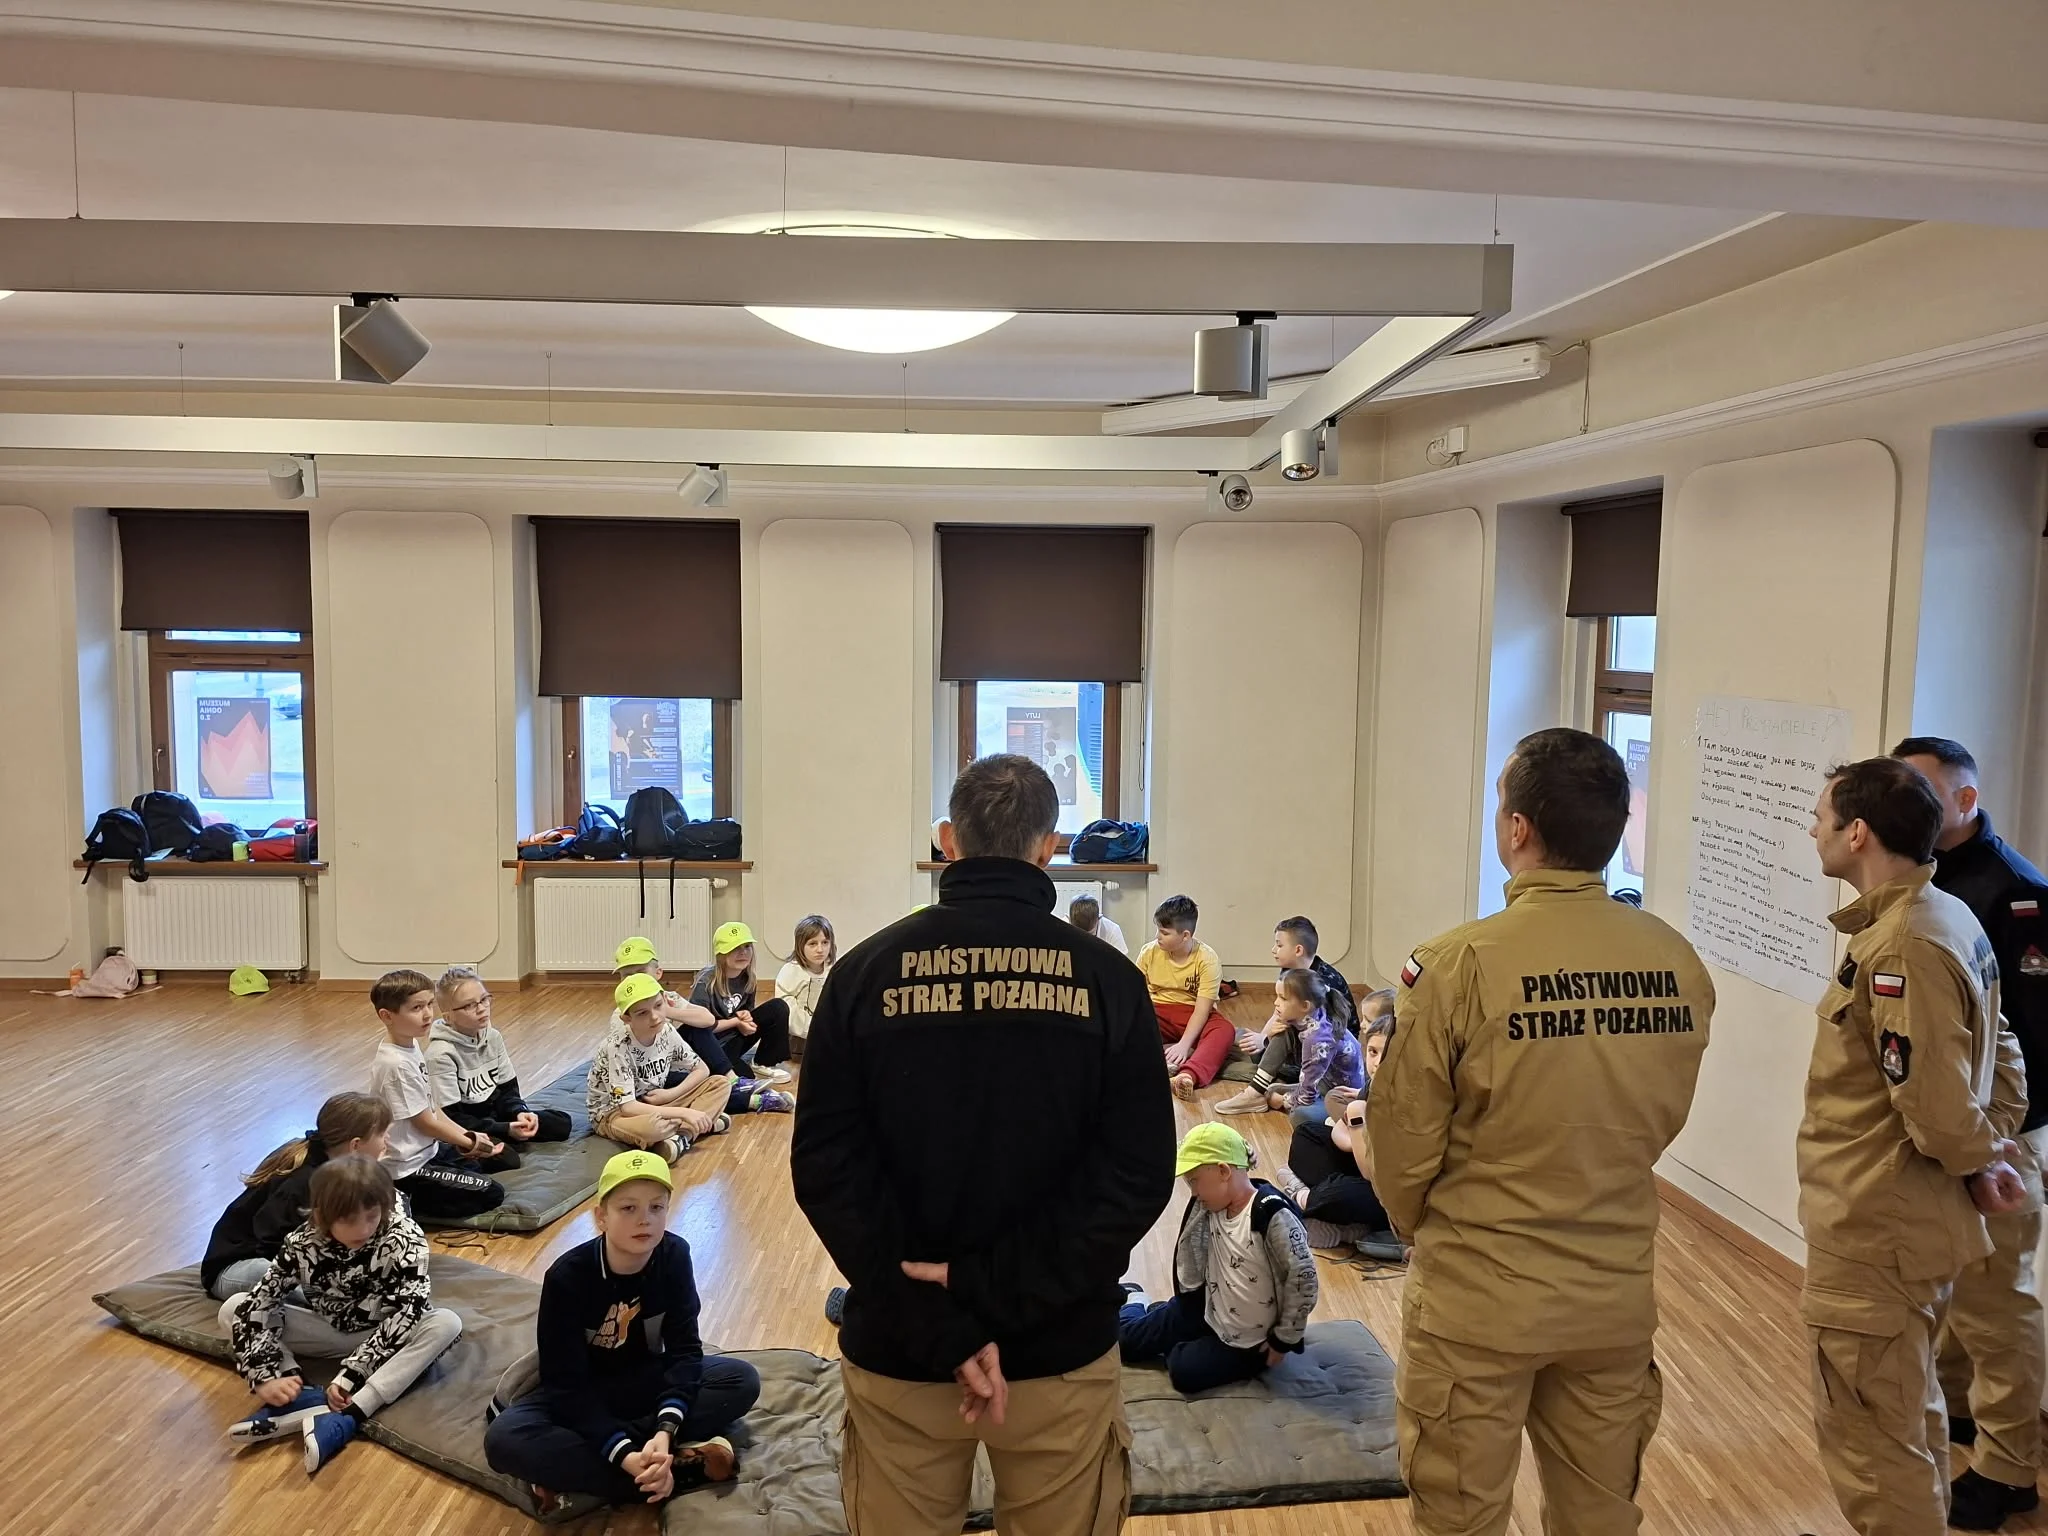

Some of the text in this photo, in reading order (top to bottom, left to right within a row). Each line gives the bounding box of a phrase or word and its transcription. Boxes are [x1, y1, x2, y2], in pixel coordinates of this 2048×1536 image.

[1784, 758, 1797, 767] NIE
[901, 945, 1073, 979] PAŃSTWOWA
[883, 980, 1090, 1018] STRAŻ POŻARNA
[1521, 968, 1680, 1003] PAŃSTWOWA
[1508, 1005, 1694, 1041] STRAŻ POŻARNA
